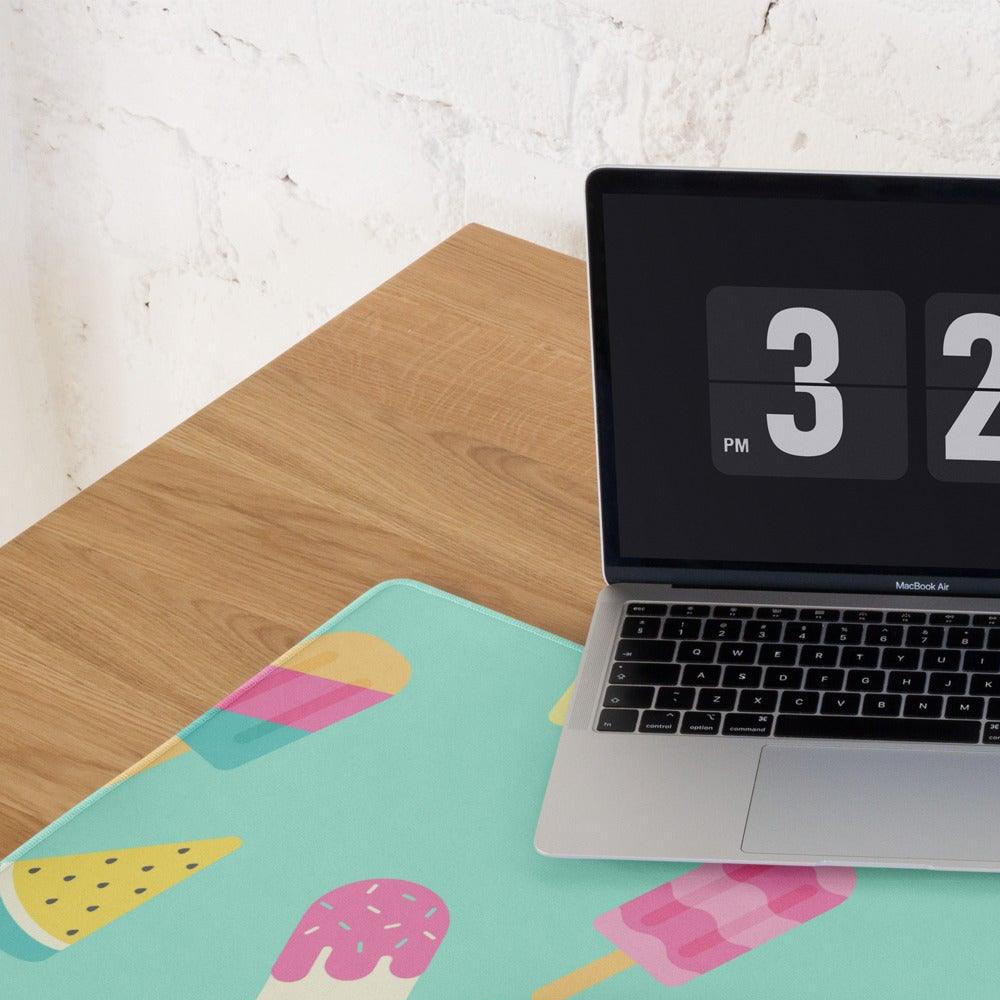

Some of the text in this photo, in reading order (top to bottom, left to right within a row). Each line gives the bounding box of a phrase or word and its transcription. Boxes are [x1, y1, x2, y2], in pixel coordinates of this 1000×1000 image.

[766, 307, 844, 457] 3
[723, 437, 749, 453] PM
[895, 581, 950, 591] MacBook Air
[718, 629, 726, 637] 2
[758, 631, 766, 639] 3
[921, 636, 928, 644] 7
[692, 648, 702, 656] Q
[732, 649, 744, 657] W
[856, 653, 864, 661] T
[937, 656, 946, 664] U
[697, 671, 705, 679] A
[779, 674, 788, 682] D
[820, 675, 828, 683] F
[712, 695, 721, 703] Z
[795, 698, 804, 706] C
[837, 699, 846, 707] V
[877, 701, 886, 709] B
[918, 702, 928, 710] N
[959, 703, 970, 711] M
